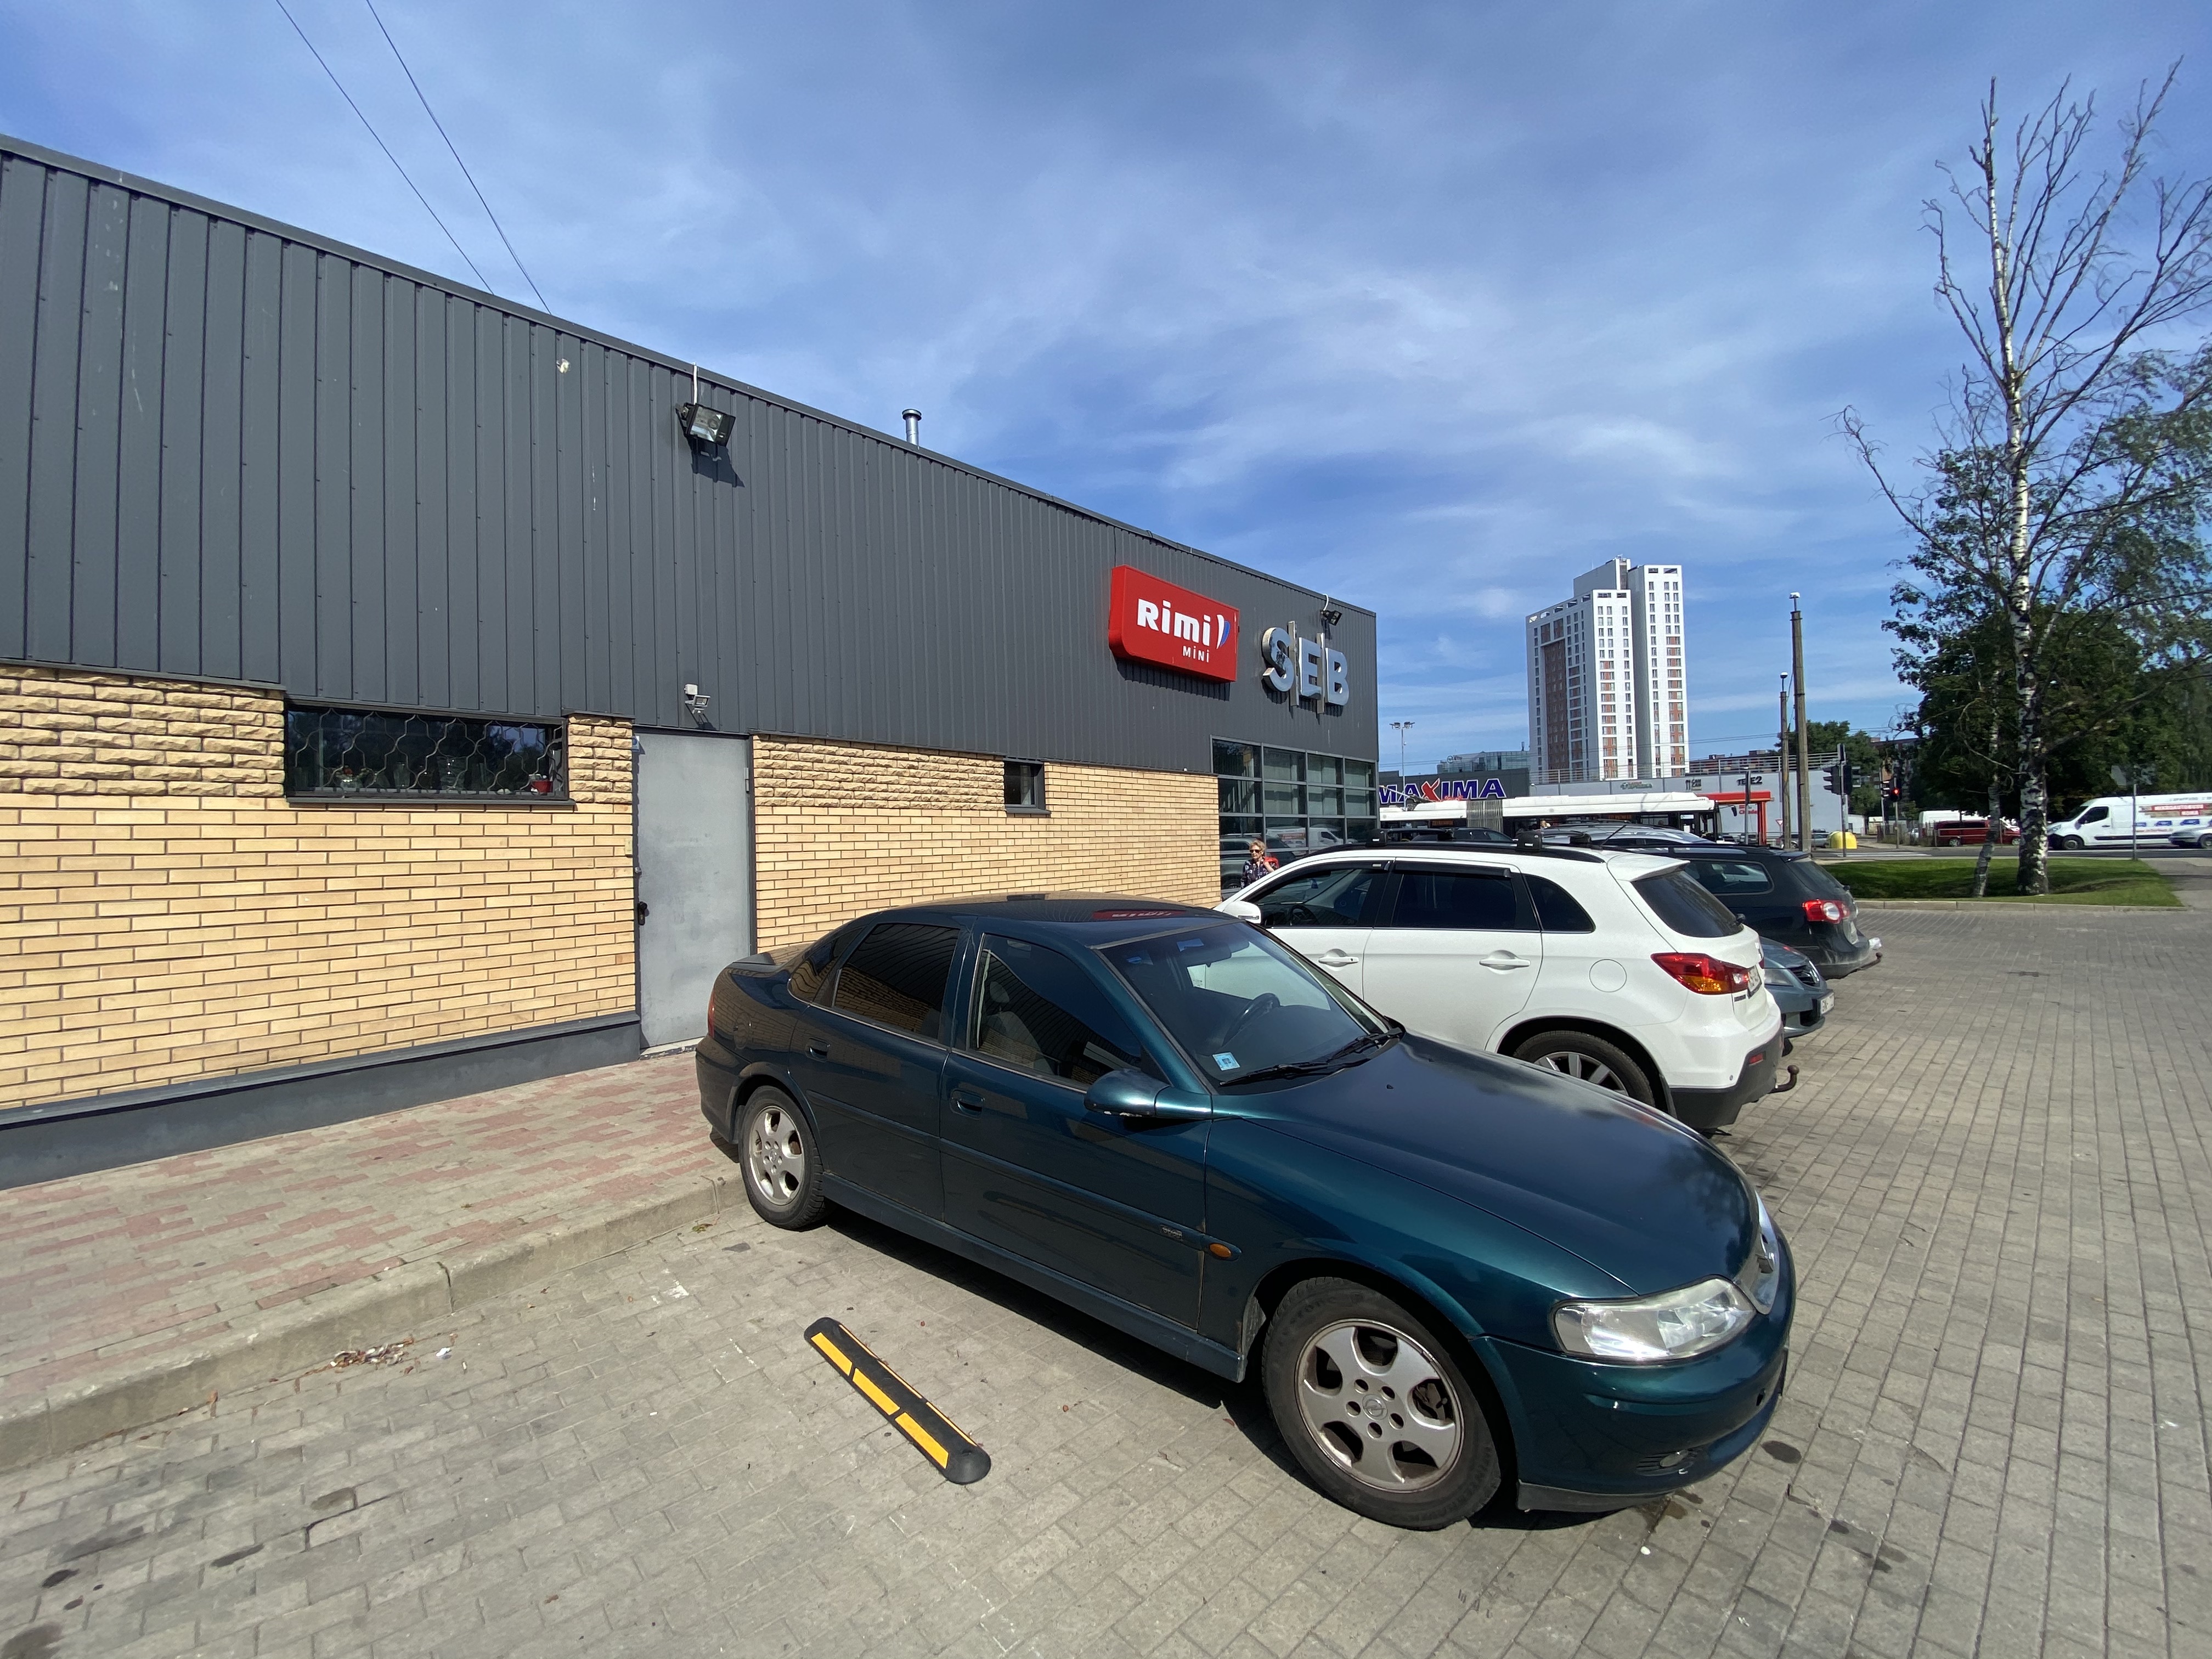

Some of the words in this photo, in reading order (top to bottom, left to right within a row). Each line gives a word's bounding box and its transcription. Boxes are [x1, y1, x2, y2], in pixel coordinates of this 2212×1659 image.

[1137, 598, 1211, 647] Rimi
[1262, 627, 1350, 706] SEB
[1379, 778, 1507, 804] MAXIMA
[1737, 776, 1763, 786] TEE2
